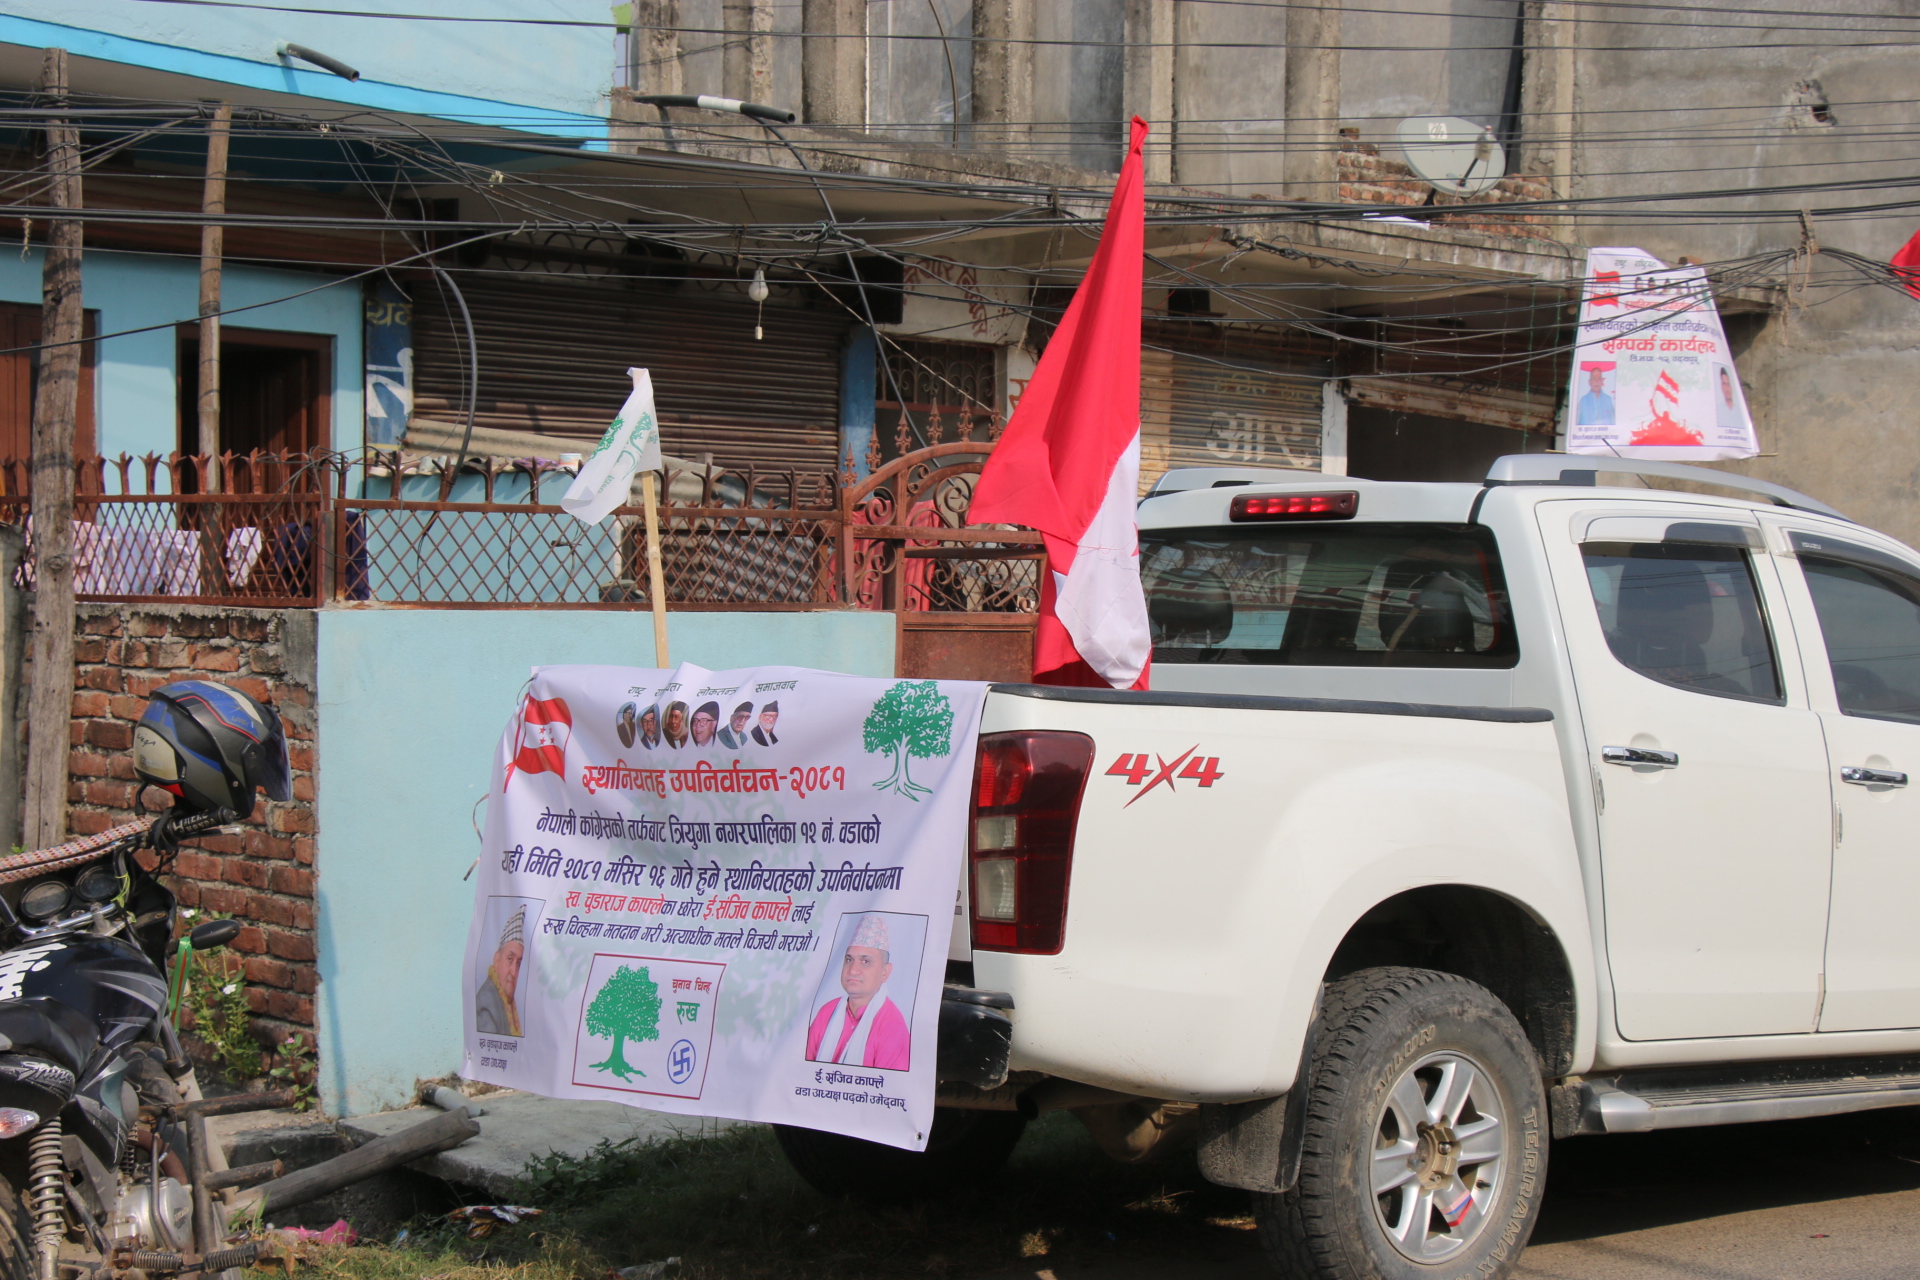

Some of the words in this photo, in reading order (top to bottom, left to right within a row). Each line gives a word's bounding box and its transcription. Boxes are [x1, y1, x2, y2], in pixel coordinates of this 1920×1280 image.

[1602, 334, 1657, 354] सम्पर्क
[582, 758, 666, 799] स्थानियतह
[669, 759, 845, 800] उपनिर्वाचन-२०८१
[536, 806, 576, 836] नेपाली
[580, 810, 626, 841] कांग्रेसको
[627, 814, 666, 842] तर्फबाट
[668, 814, 711, 850] त्रियुगा
[714, 814, 797, 845] नगरपालिका
[801, 821, 817, 844] १२
[839, 813, 881, 844] वडाको
[501, 844, 524, 875] यही
[523, 846, 563, 878] मिति
[563, 858, 602, 881] २०८१
[604, 854, 646, 886] मंसिर
[649, 864, 666, 889] १६
[670, 859, 694, 889] गते
[696, 860, 721, 896] हुने
[724, 859, 816, 894] स्थानियतहको
[816, 860, 904, 892] उपनिर्वाचनमा
[584, 892, 628, 914] चुडाराज
[676, 896, 704, 918] छोरा
[751, 896, 793, 922] काफ्ले
[791, 901, 816, 924] लाई
[565, 915, 604, 938] चिन्हमा
[603, 923, 641, 941] मतदान
[640, 922, 663, 943] गरी
[662, 925, 714, 947] अत्याधीक
[713, 928, 744, 949] मतले
[743, 927, 779, 951] विजयी
[672, 978, 692, 994] चुनाव
[694, 976, 712, 995] चिन्ह
[676, 1001, 701, 1025] रुख
[795, 1086, 811, 1097] वडा
[812, 1088, 841, 1102] अध्यक्ष
[842, 1091, 868, 1104] पदको
[854, 1075, 884, 1089] काफ्ले
[1477, 1107, 1539, 1279] TERRAMAX
